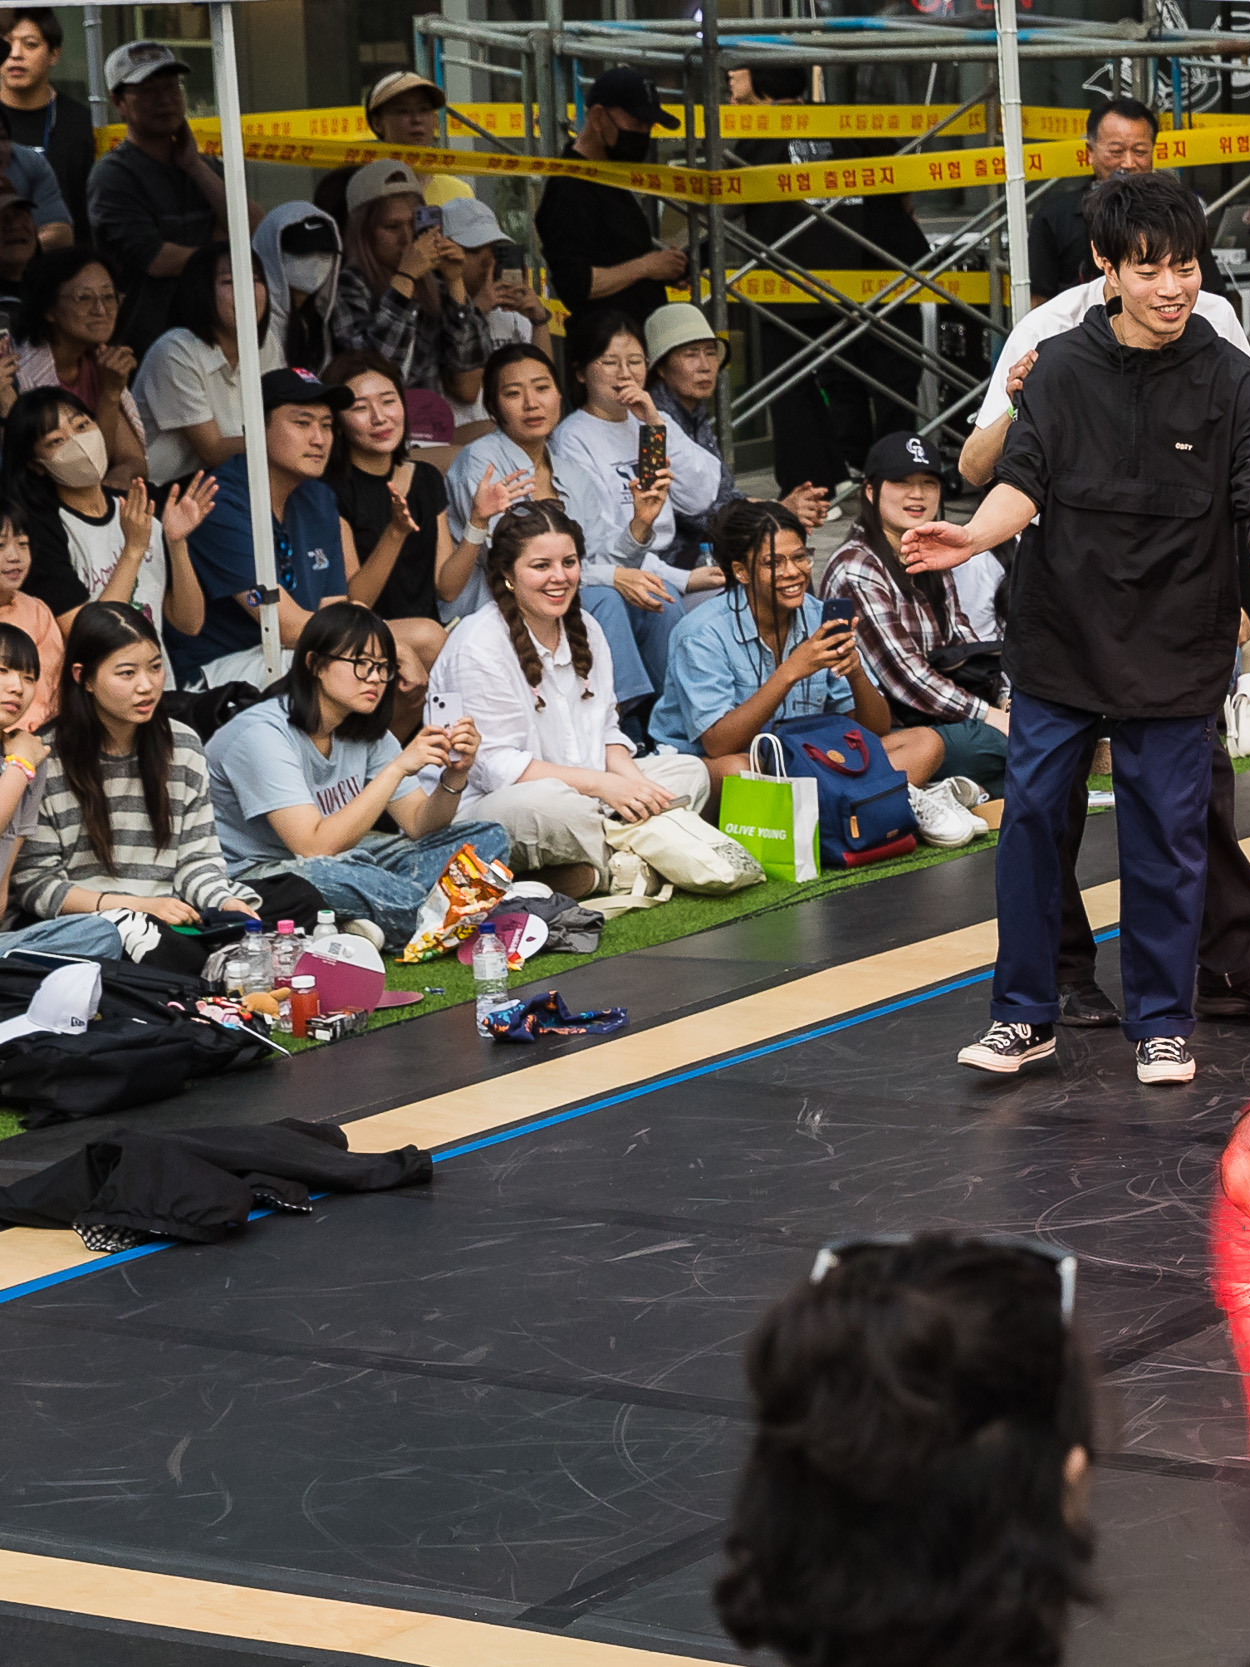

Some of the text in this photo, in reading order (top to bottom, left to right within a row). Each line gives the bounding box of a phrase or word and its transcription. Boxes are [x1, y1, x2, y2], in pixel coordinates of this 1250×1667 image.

[1219, 135, 1250, 155] 위험
[929, 153, 1042, 181] 위험 출입지
[673, 174, 742, 197] 출입금지
[777, 166, 895, 193] 위험 출입금지
[1175, 442, 1193, 451] OBEY
[725, 823, 756, 837] OLIVE
